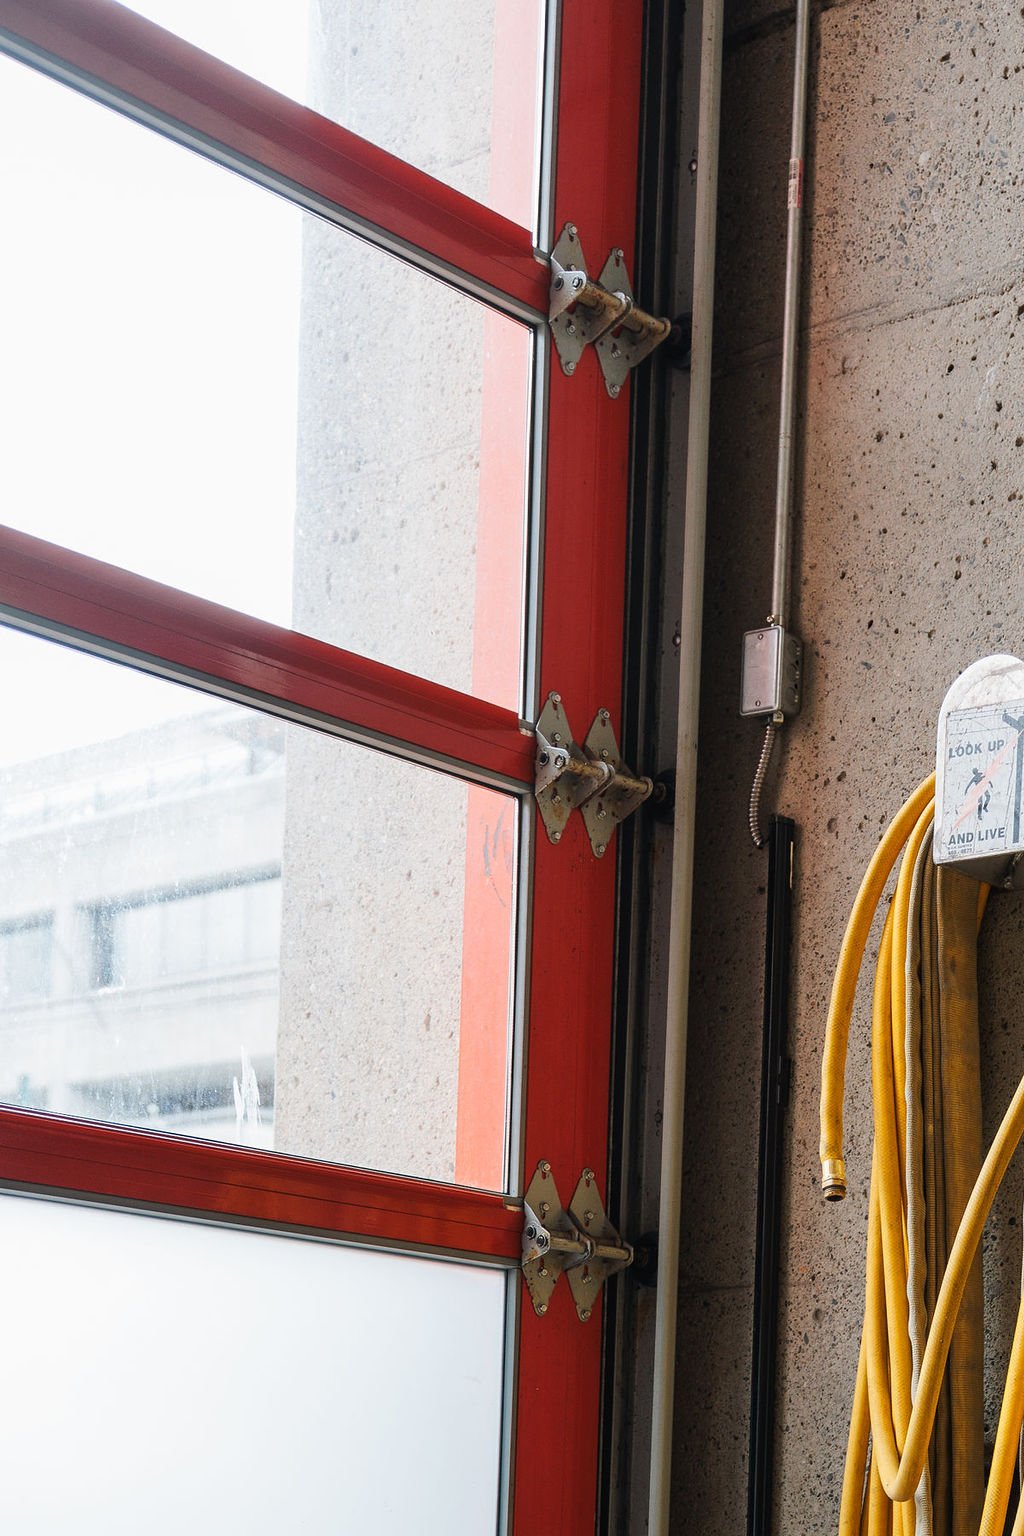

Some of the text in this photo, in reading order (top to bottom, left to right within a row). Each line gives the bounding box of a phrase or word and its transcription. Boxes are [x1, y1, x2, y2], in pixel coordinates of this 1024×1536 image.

[948, 739, 1005, 760] LOOK UP
[948, 827, 1006, 846] AND LIVE
